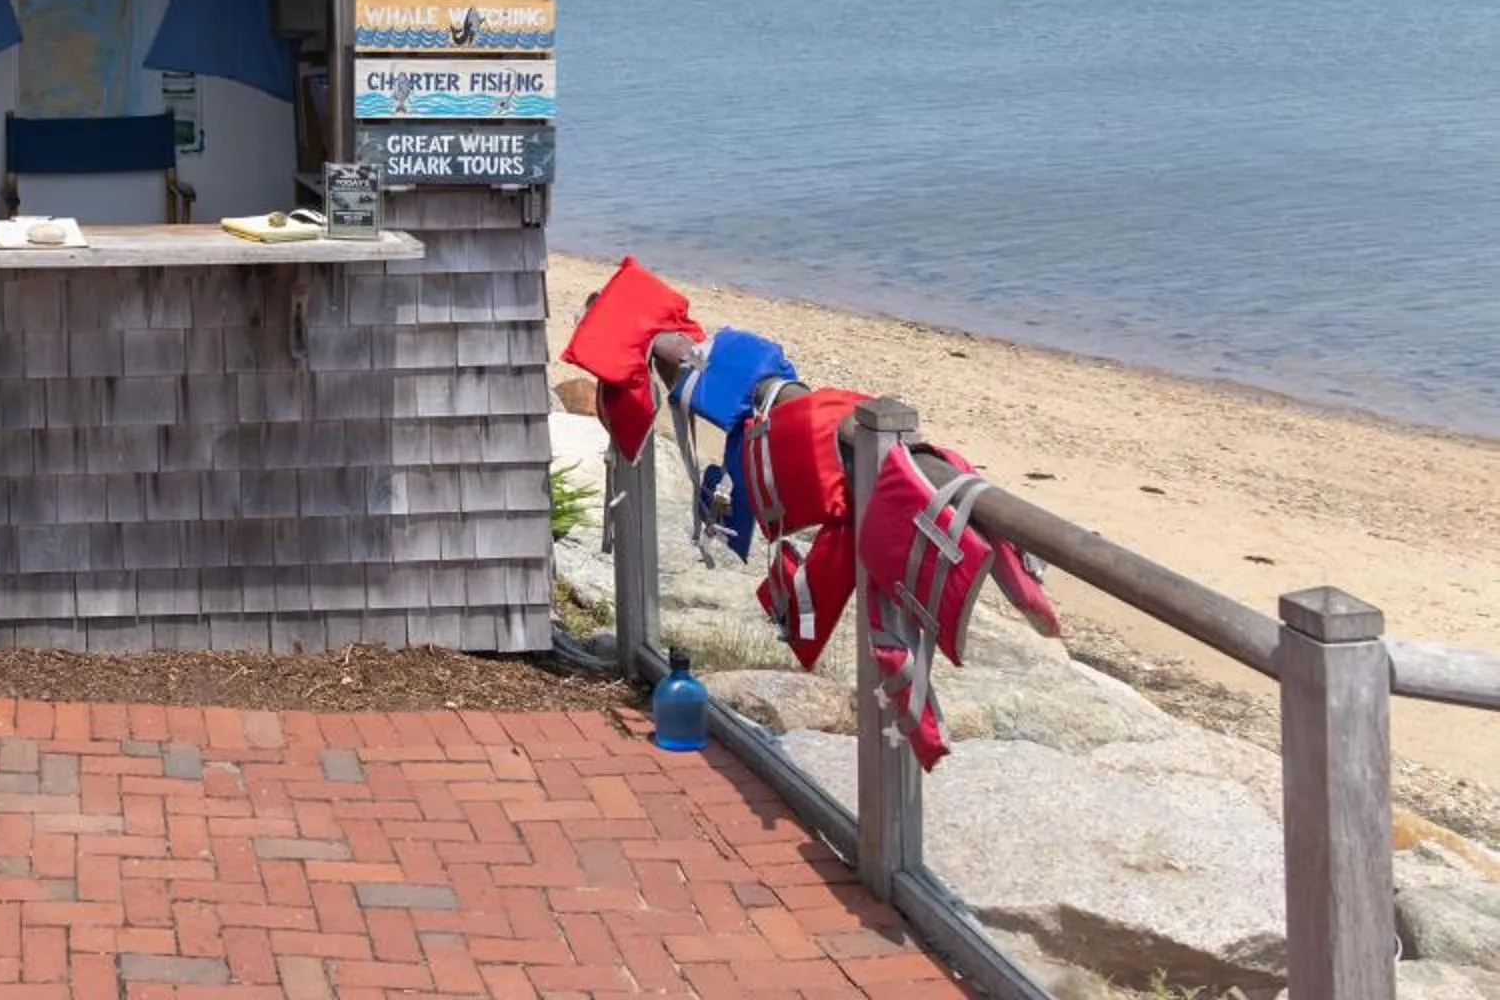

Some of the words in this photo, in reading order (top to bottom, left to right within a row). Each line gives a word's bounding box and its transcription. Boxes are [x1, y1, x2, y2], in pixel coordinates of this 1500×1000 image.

[364, 5, 439, 25] WHALE
[448, 7, 547, 26] WTCHING
[387, 135, 454, 153] GREAT
[460, 135, 524, 153] WHITE
[387, 155, 451, 175] SHARK
[458, 156, 524, 175] TOURS
